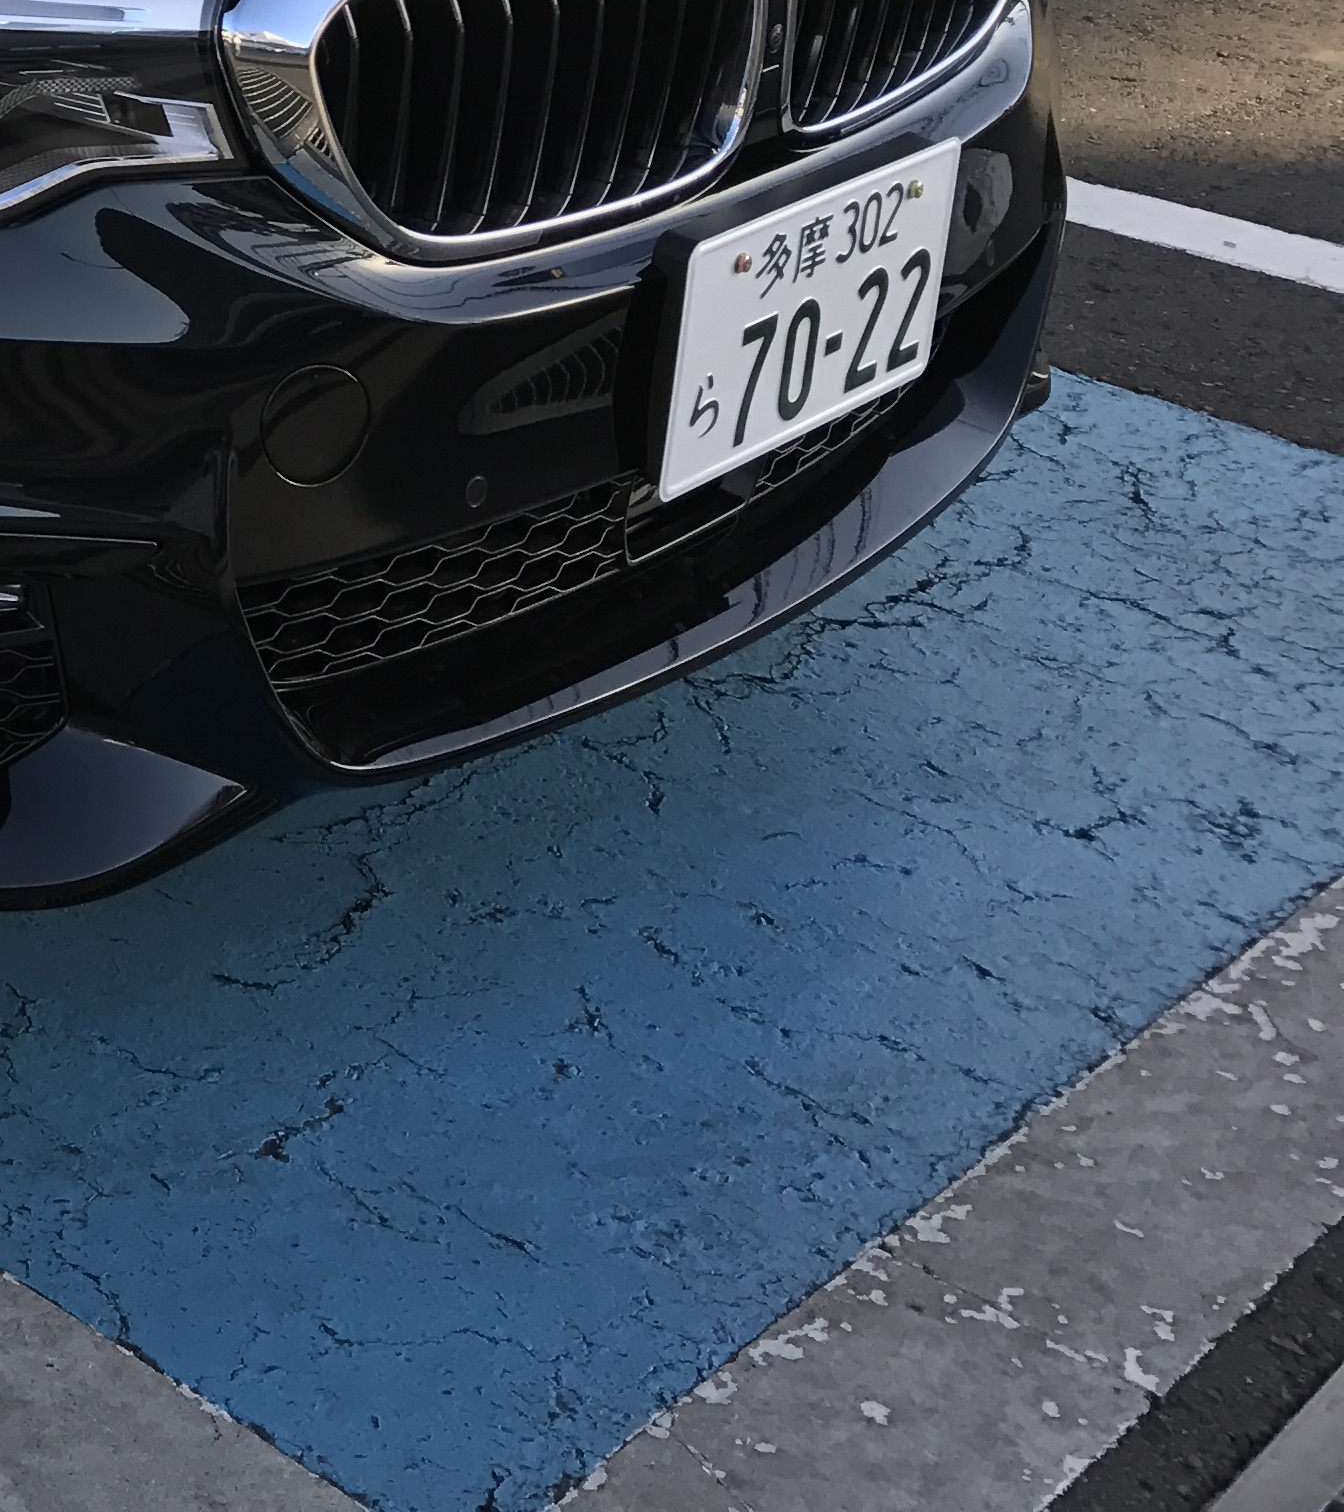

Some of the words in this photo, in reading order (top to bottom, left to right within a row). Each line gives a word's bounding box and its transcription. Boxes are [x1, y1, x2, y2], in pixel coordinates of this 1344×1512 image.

[755, 214, 834, 299] 多摩
[835, 182, 905, 264] 302
[689, 372, 720, 438] ら
[732, 247, 932, 449] 70-22
